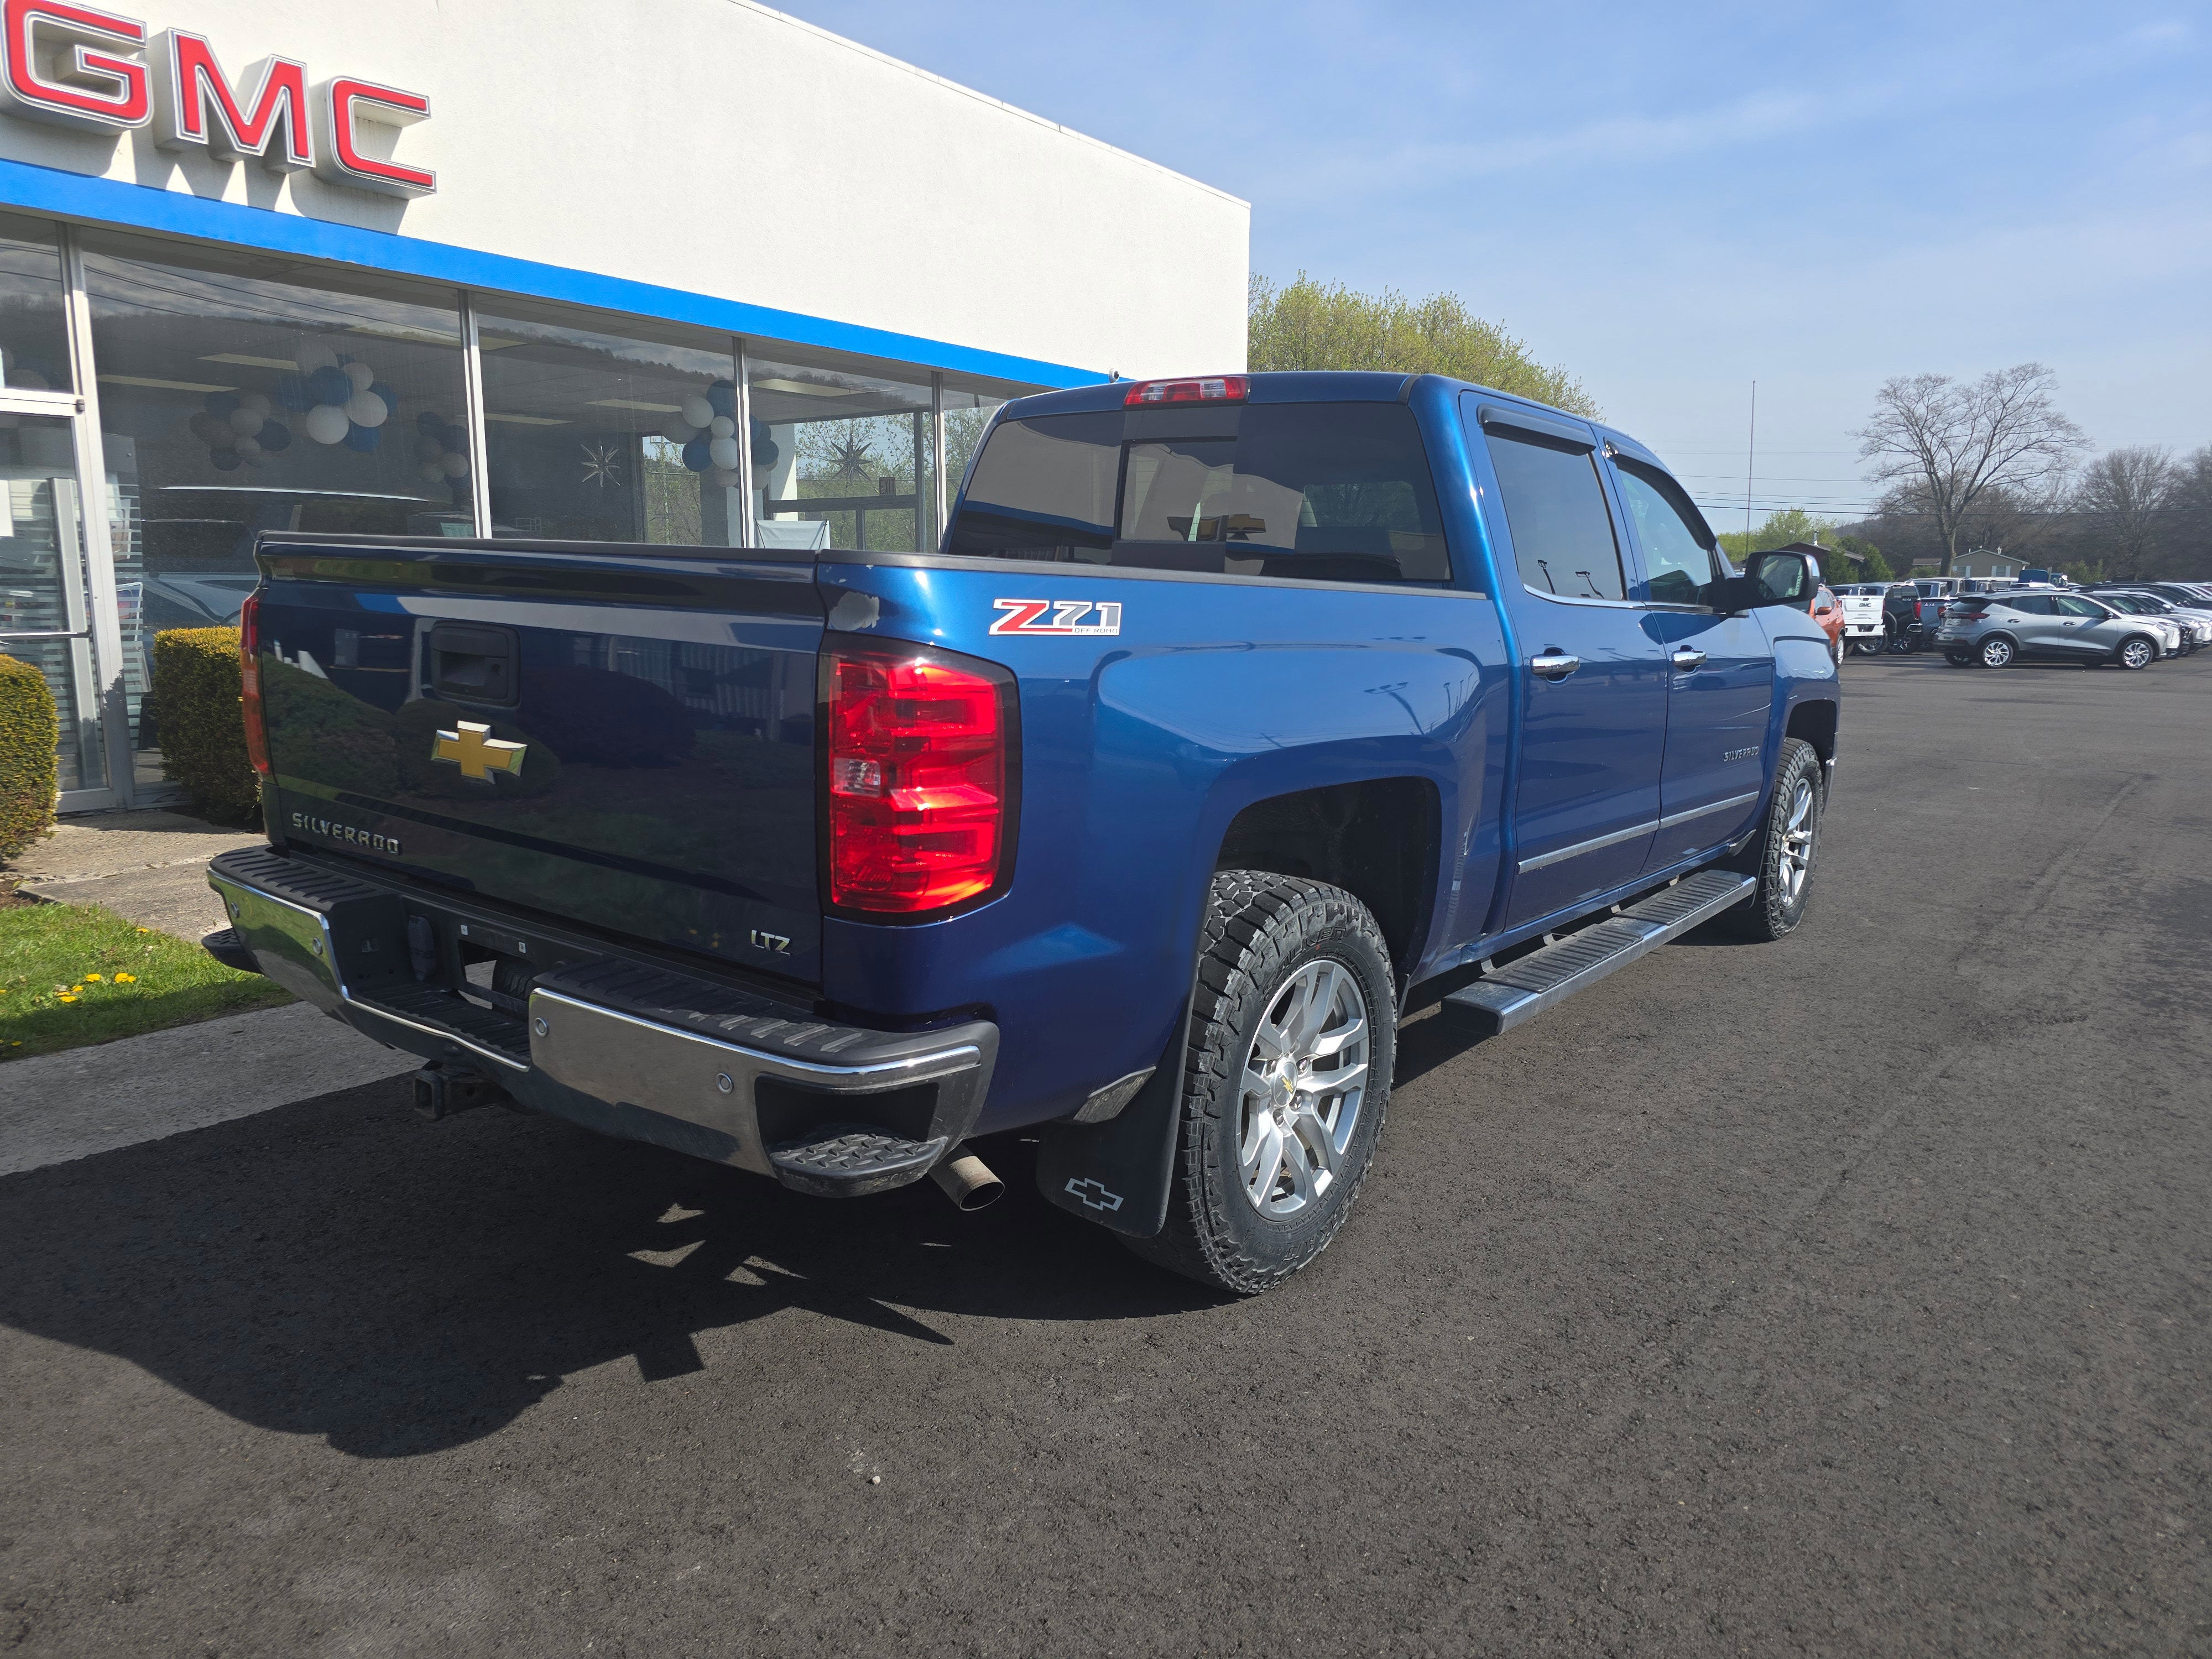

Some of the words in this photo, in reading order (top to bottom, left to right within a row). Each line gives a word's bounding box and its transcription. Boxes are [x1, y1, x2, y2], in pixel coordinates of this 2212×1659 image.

[0, 0, 437, 194] GMC
[989, 598, 1122, 635] Z71
[1723, 745, 1759, 762] SILVERADO
[292, 812, 400, 855] SILVERADO
[751, 929, 790, 956] LTZ
